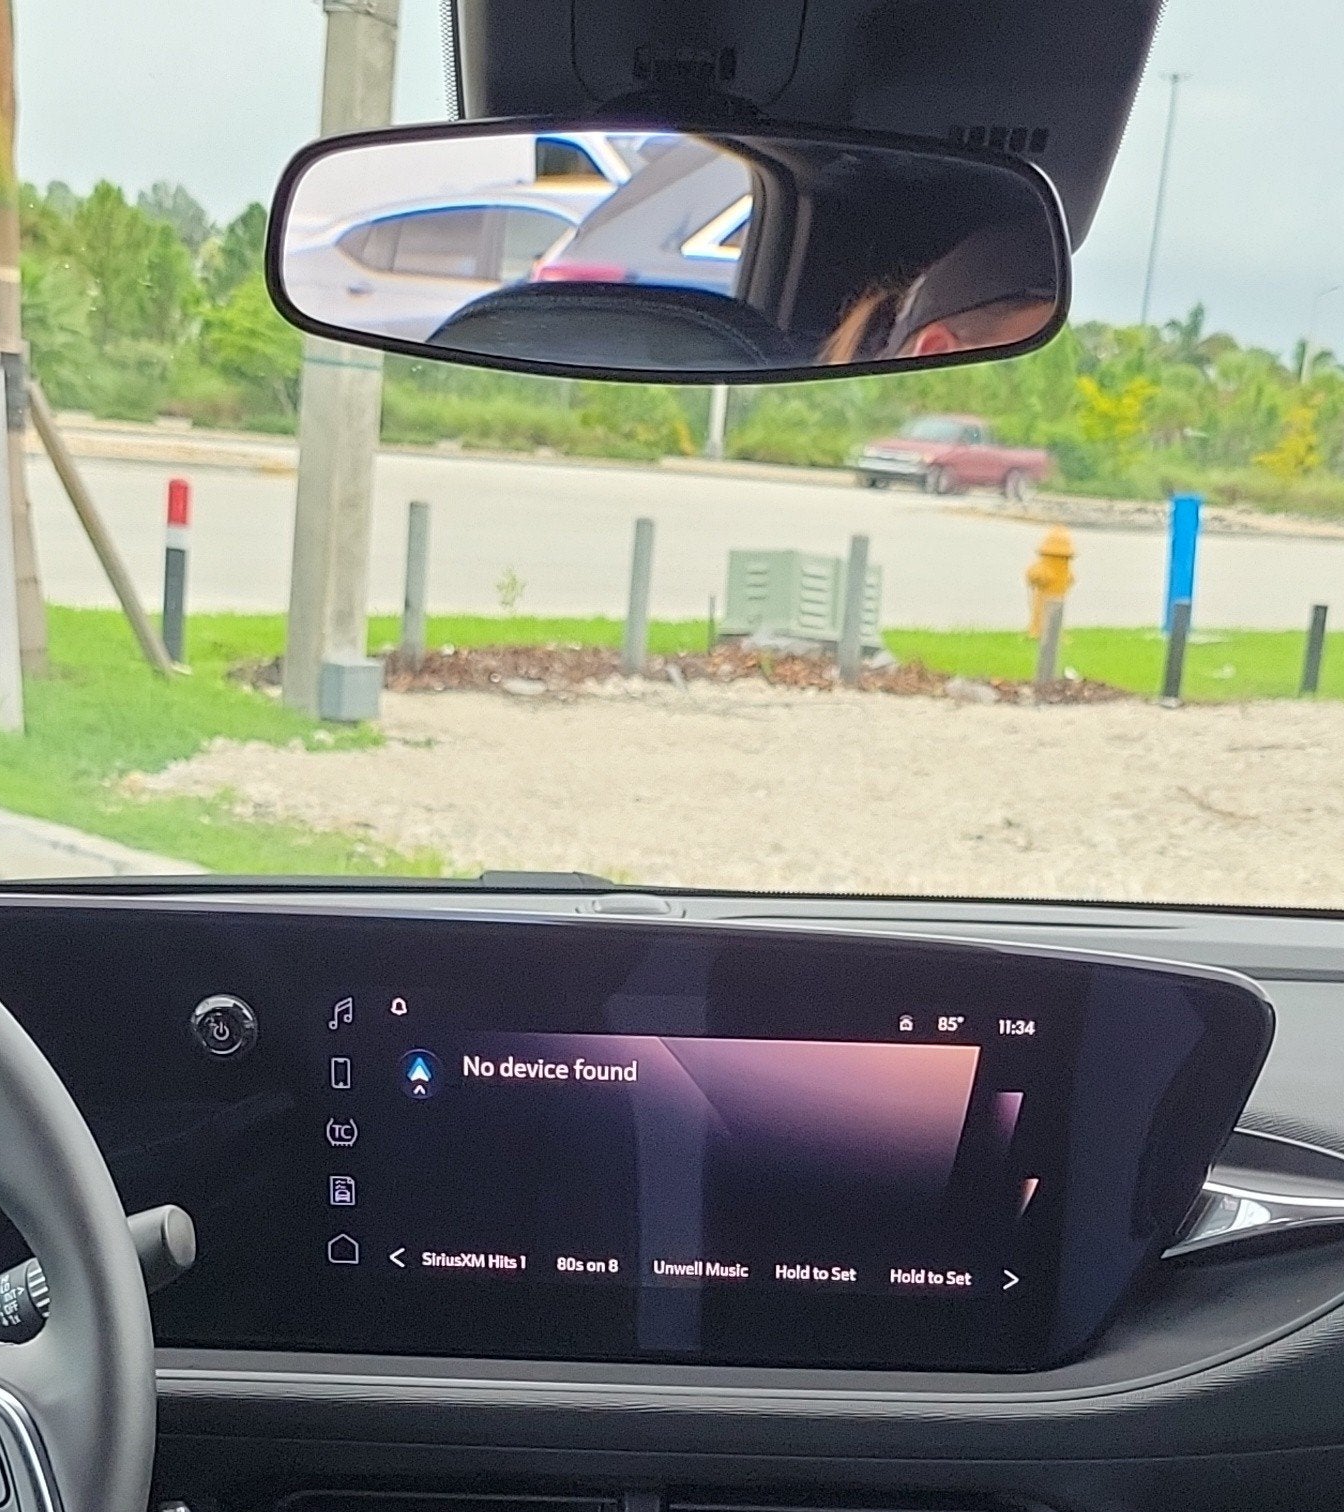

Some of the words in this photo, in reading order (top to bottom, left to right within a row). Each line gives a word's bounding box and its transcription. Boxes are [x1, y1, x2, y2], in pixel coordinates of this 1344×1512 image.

[937, 1016, 965, 1032] 85°
[998, 1019, 1036, 1035] 11:34
[462, 1056, 495, 1078] No
[499, 1056, 569, 1080] device
[573, 1059, 638, 1082] found
[331, 1124, 352, 1139] TC
[421, 1252, 485, 1268] SiriusXM
[488, 1254, 518, 1269] Hits
[520, 1255, 527, 1270] 1
[556, 1257, 585, 1272] 80s
[586, 1261, 606, 1272] on
[607, 1259, 619, 1273] 8
[653, 1260, 703, 1276] Unwell
[705, 1262, 749, 1278] Music
[775, 1264, 810, 1280] Hold
[813, 1267, 829, 1280] to
[831, 1267, 857, 1282] Set
[890, 1268, 925, 1284] Hold
[928, 1270, 944, 1285] to
[946, 1271, 972, 1286] Set
[3, 1300, 18, 1315] OFF
